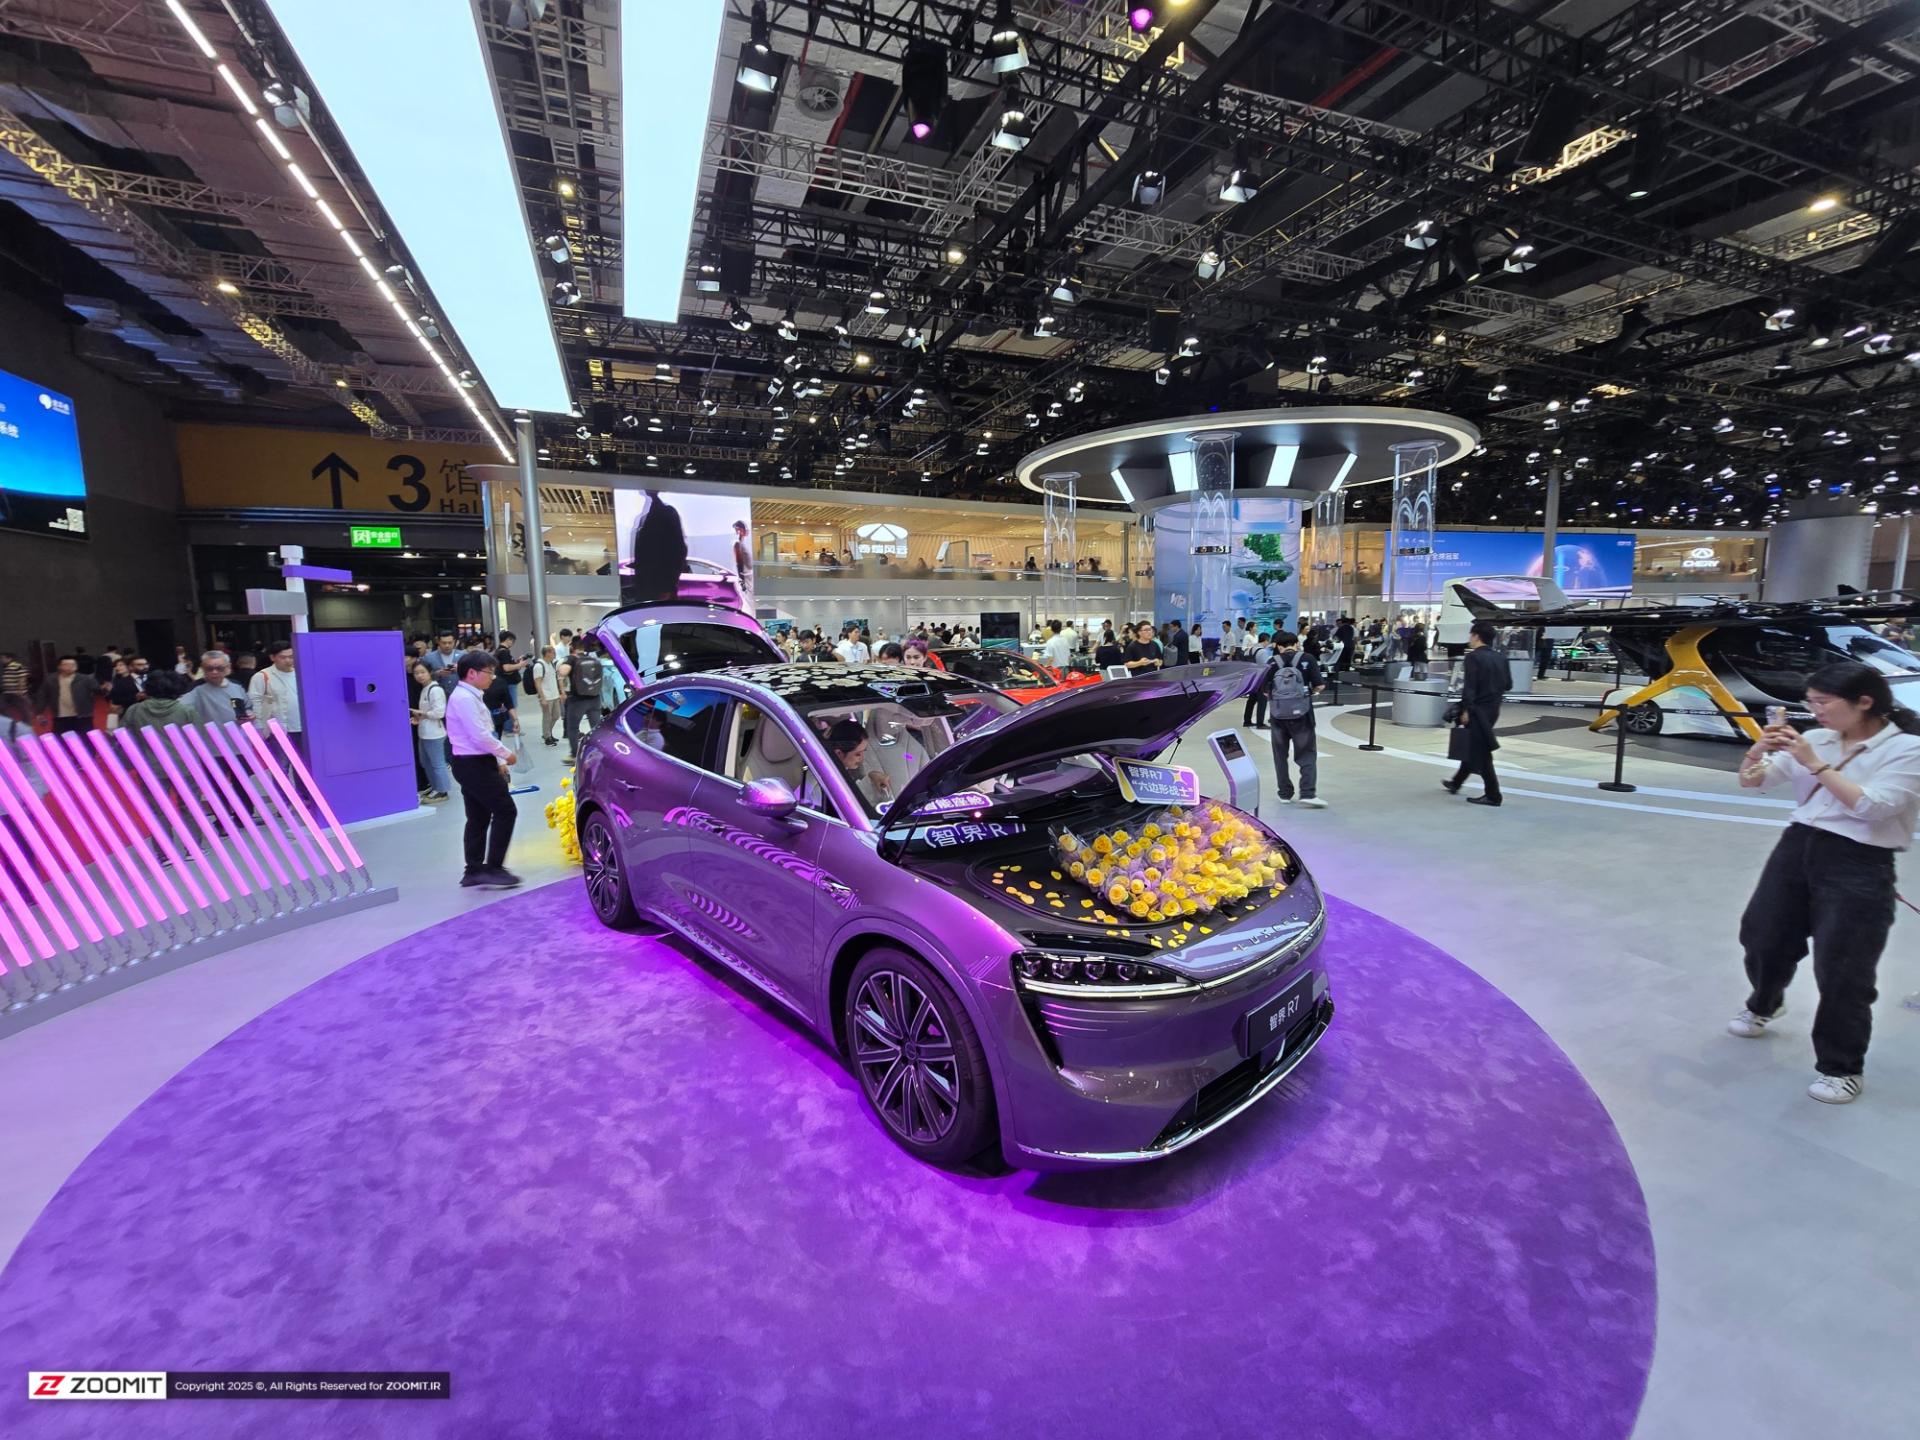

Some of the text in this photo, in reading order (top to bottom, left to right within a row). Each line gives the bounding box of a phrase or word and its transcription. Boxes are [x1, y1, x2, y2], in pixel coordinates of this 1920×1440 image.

[386, 454, 479, 513] 3 馆
[1682, 560, 1720, 568] CHERY
[1128, 765, 1163, 780] 智界R7
[1287, 994, 1300, 1017] R7
